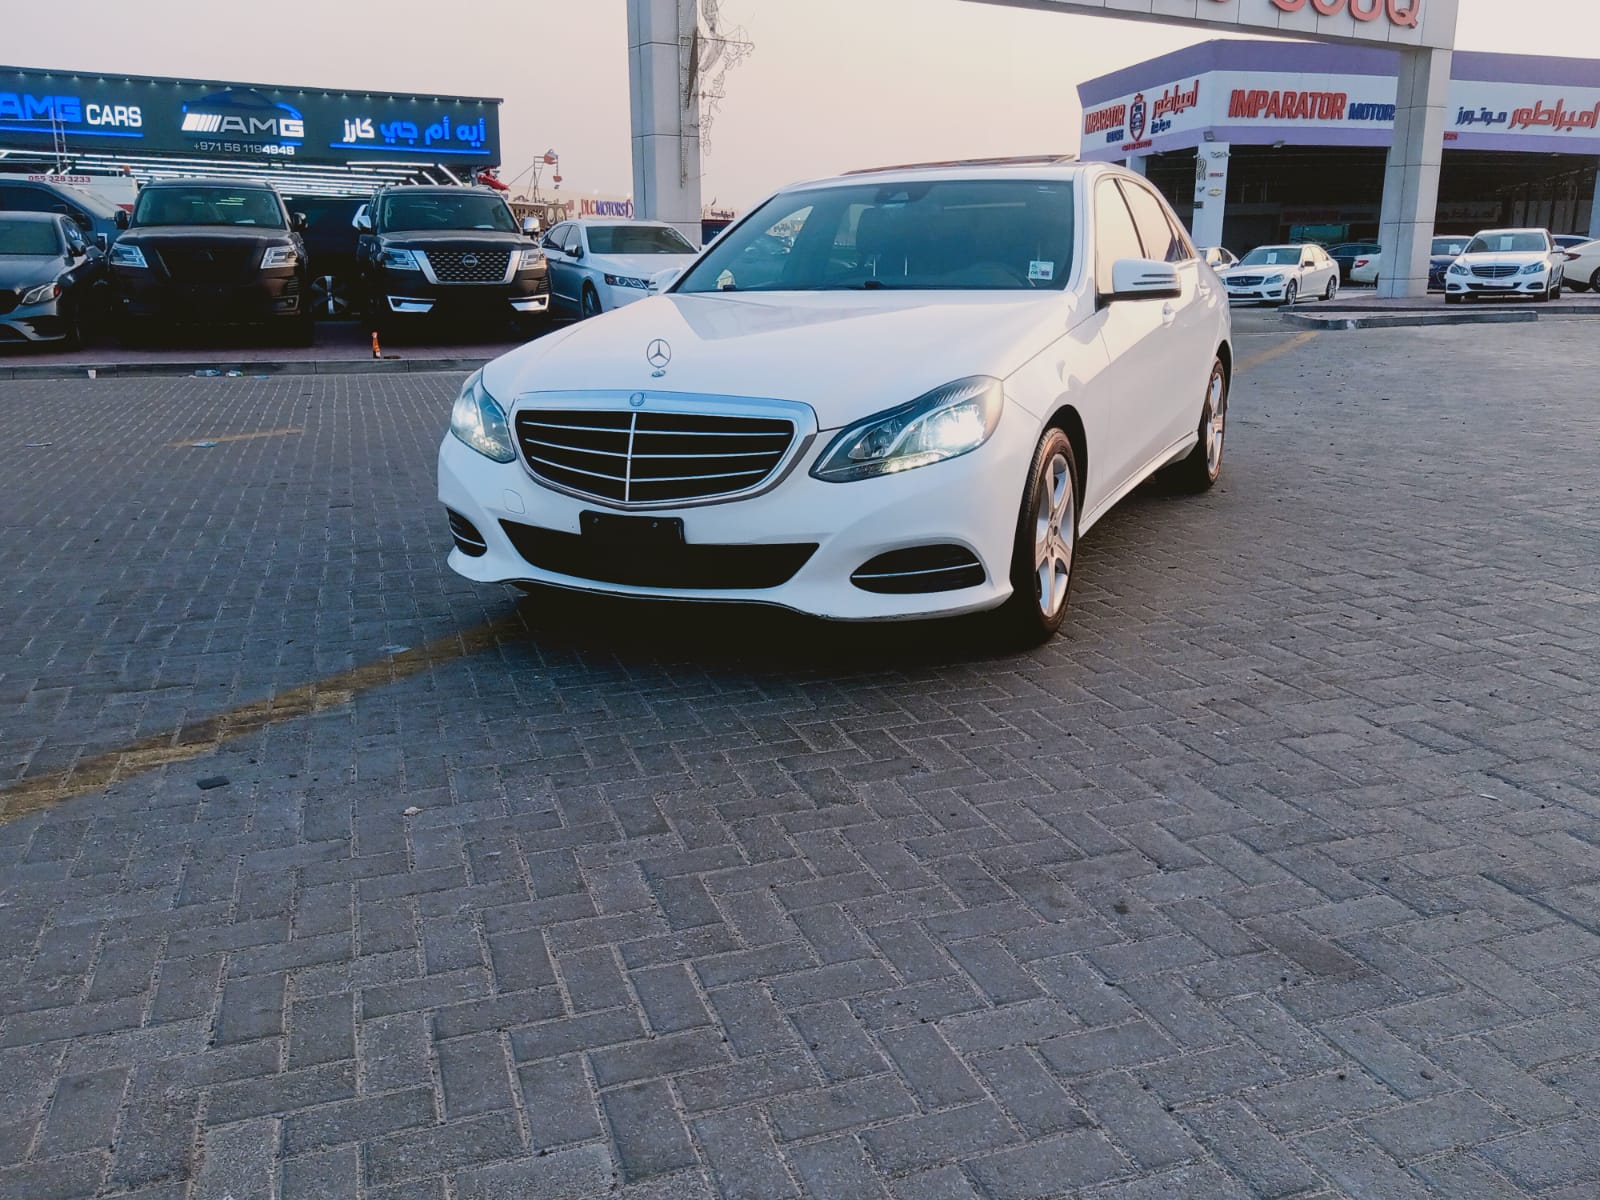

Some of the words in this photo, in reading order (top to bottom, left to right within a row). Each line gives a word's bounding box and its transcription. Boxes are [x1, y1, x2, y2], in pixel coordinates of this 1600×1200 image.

[0, 92, 82, 122] AMG
[86, 103, 143, 127] CARS
[1228, 89, 1347, 120] IMPARATOR
[1348, 103, 1395, 121] MOTOR
[220, 115, 305, 138] AMG
[194, 141, 222, 152] +971
[224, 143, 241, 153] 56
